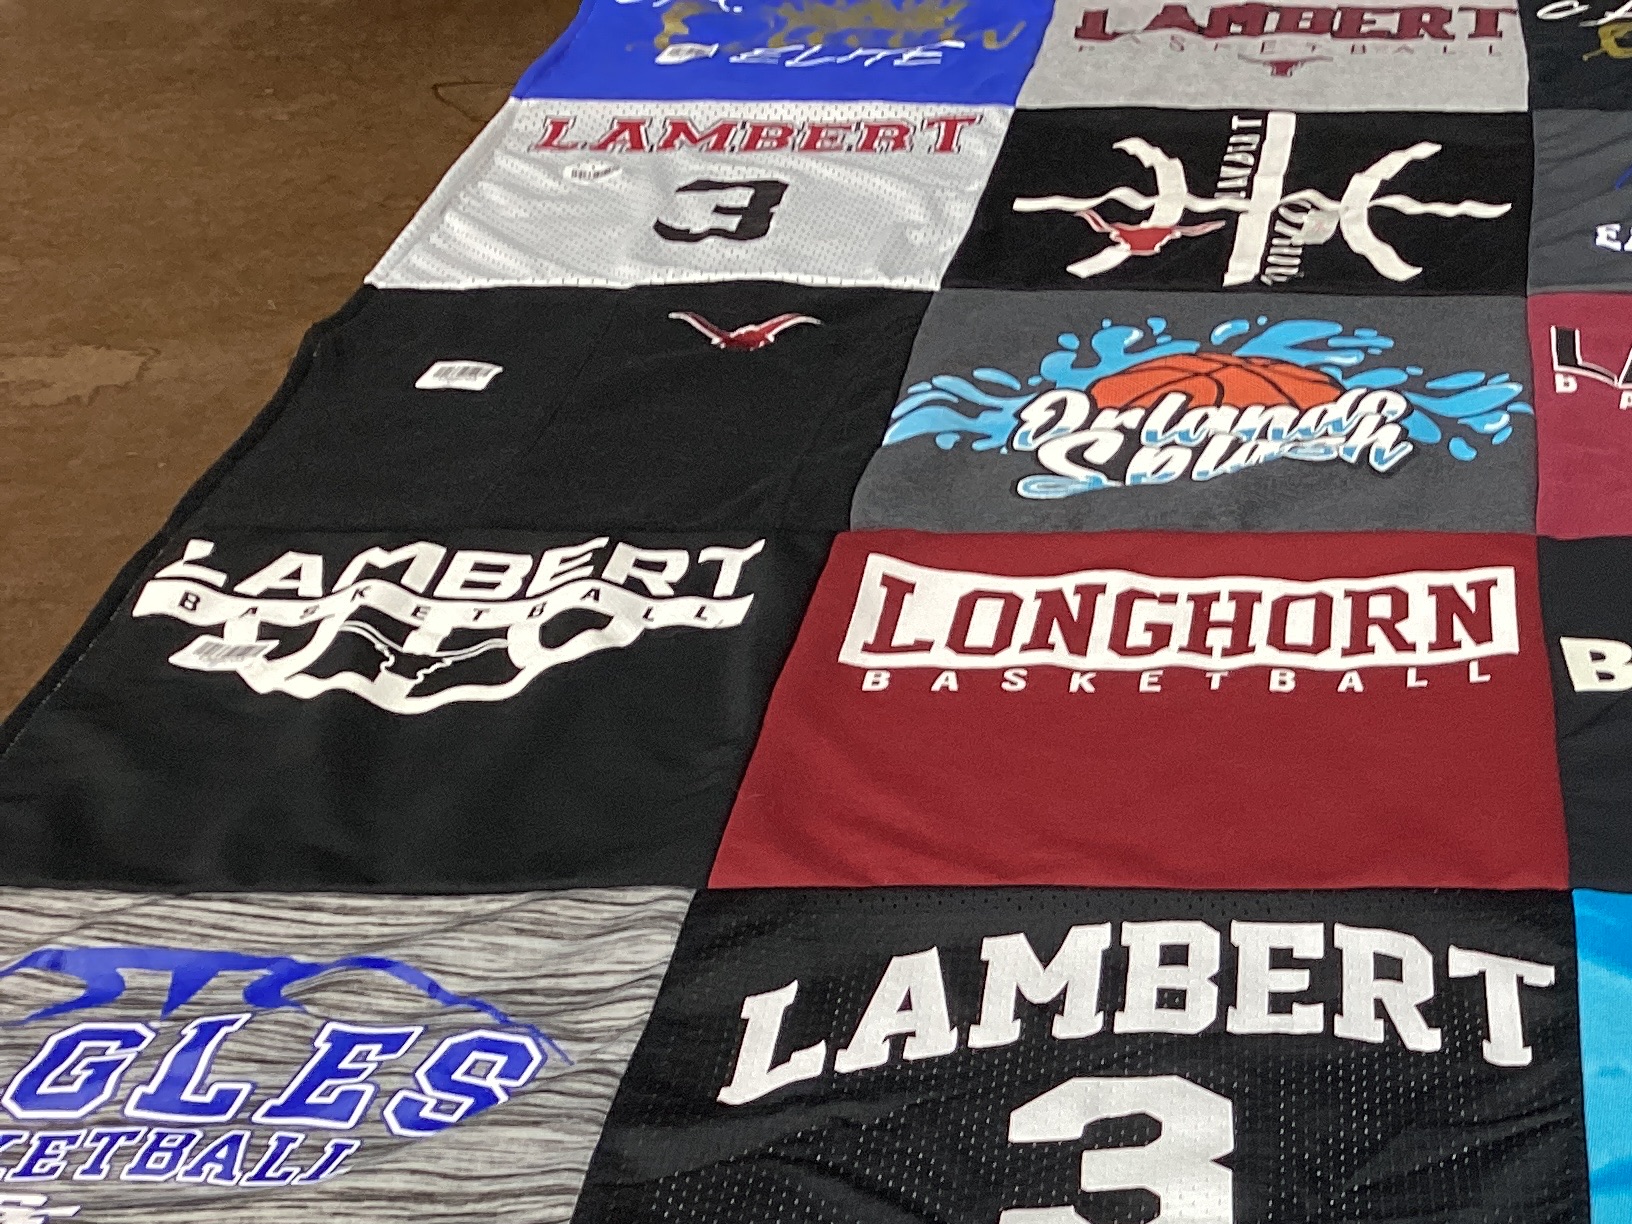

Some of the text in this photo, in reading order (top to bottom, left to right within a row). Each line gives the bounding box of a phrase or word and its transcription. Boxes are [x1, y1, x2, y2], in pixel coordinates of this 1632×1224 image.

[529, 115, 984, 153] LAMBERT
[653, 180, 790, 243] 3
[1009, 386, 1414, 451] Orlando
[154, 537, 767, 600] LAMBERT
[860, 571, 1499, 658] LONGHORN
[861, 658, 1494, 694] BASKETBALL
[714, 917, 1557, 1106] LAMBERT
